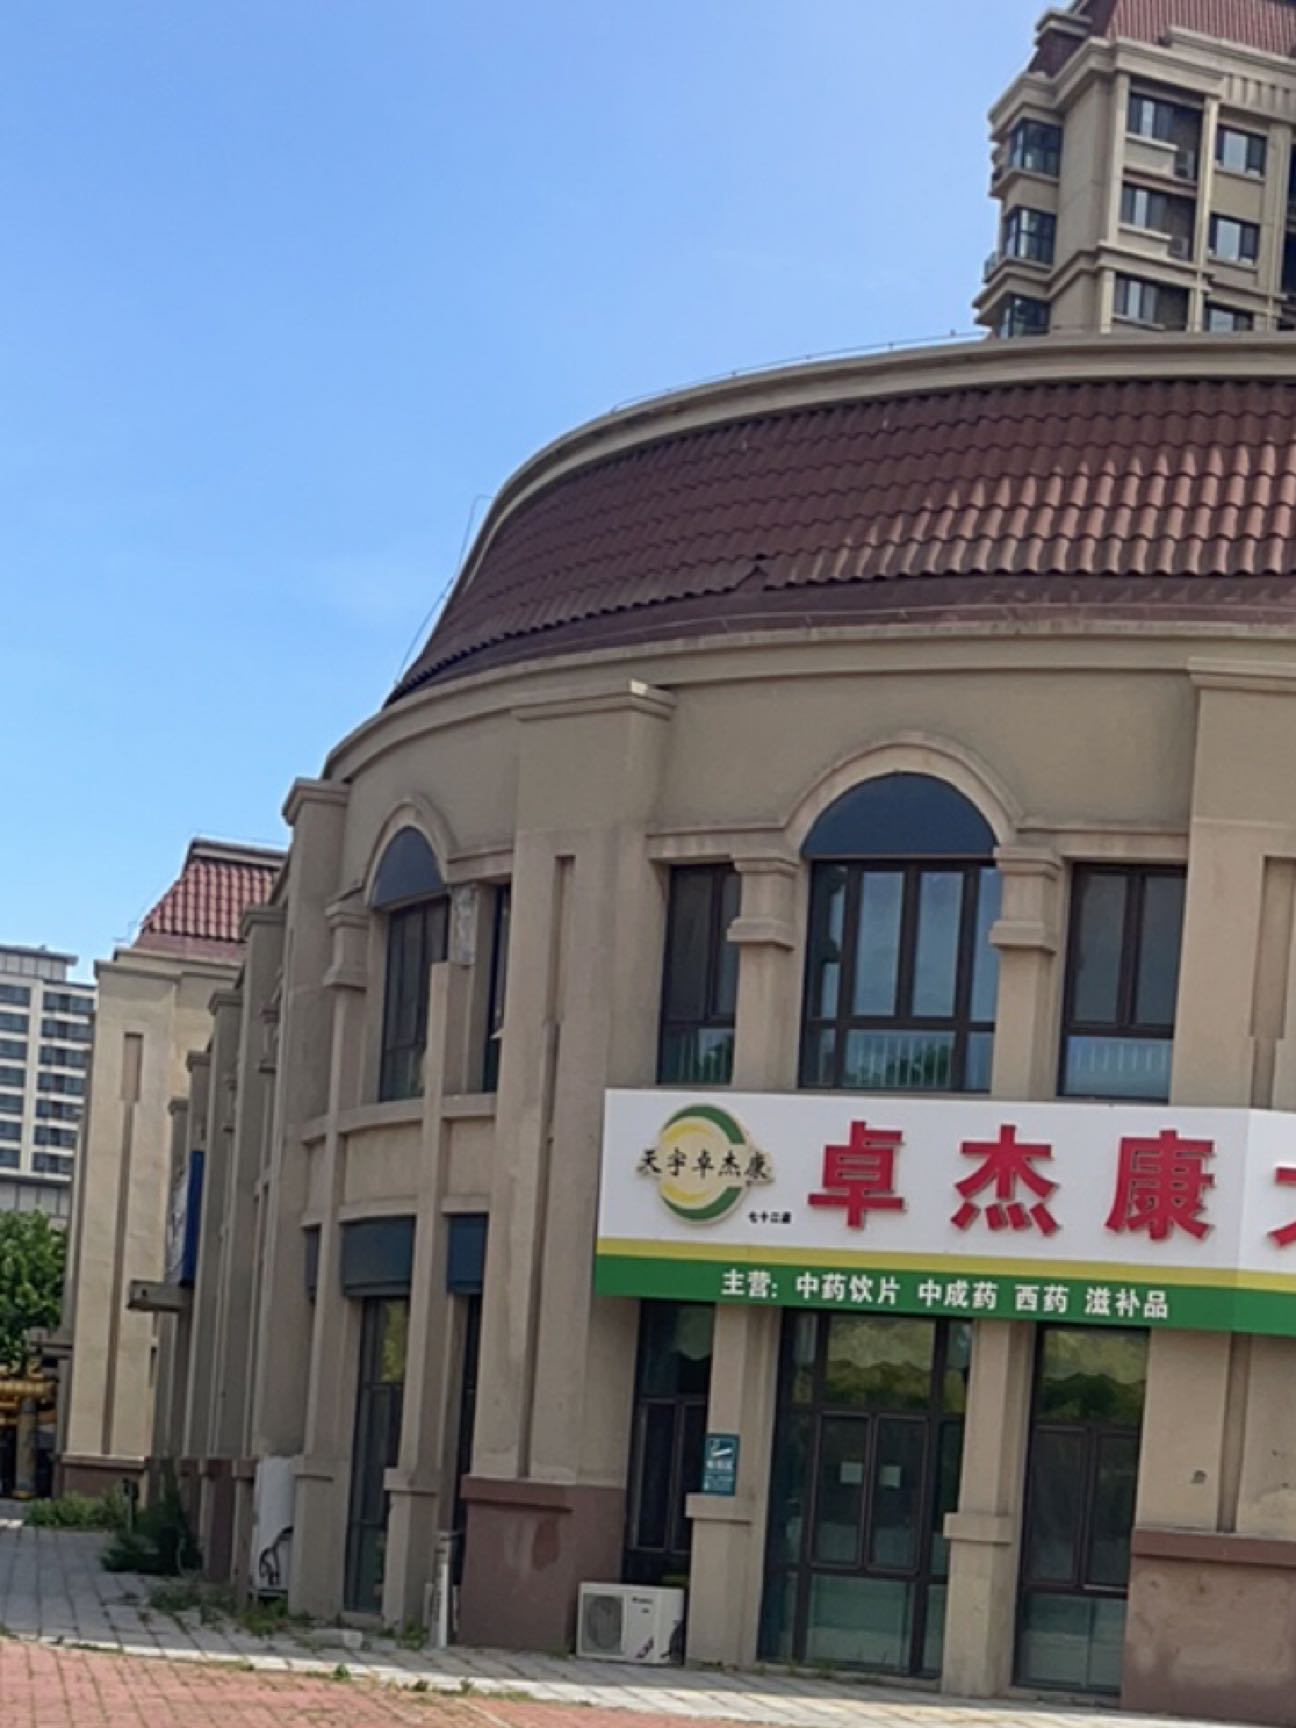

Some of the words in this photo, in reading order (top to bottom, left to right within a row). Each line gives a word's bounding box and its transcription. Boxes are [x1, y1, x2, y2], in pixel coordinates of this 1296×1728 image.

[722, 1269, 778, 1299] 主营:
[796, 1271, 900, 1305] 中药饮片
[918, 1279, 999, 1311] 中成药
[1015, 1284, 1069, 1314] 西药
[1085, 1287, 1168, 1319] 滋补品
